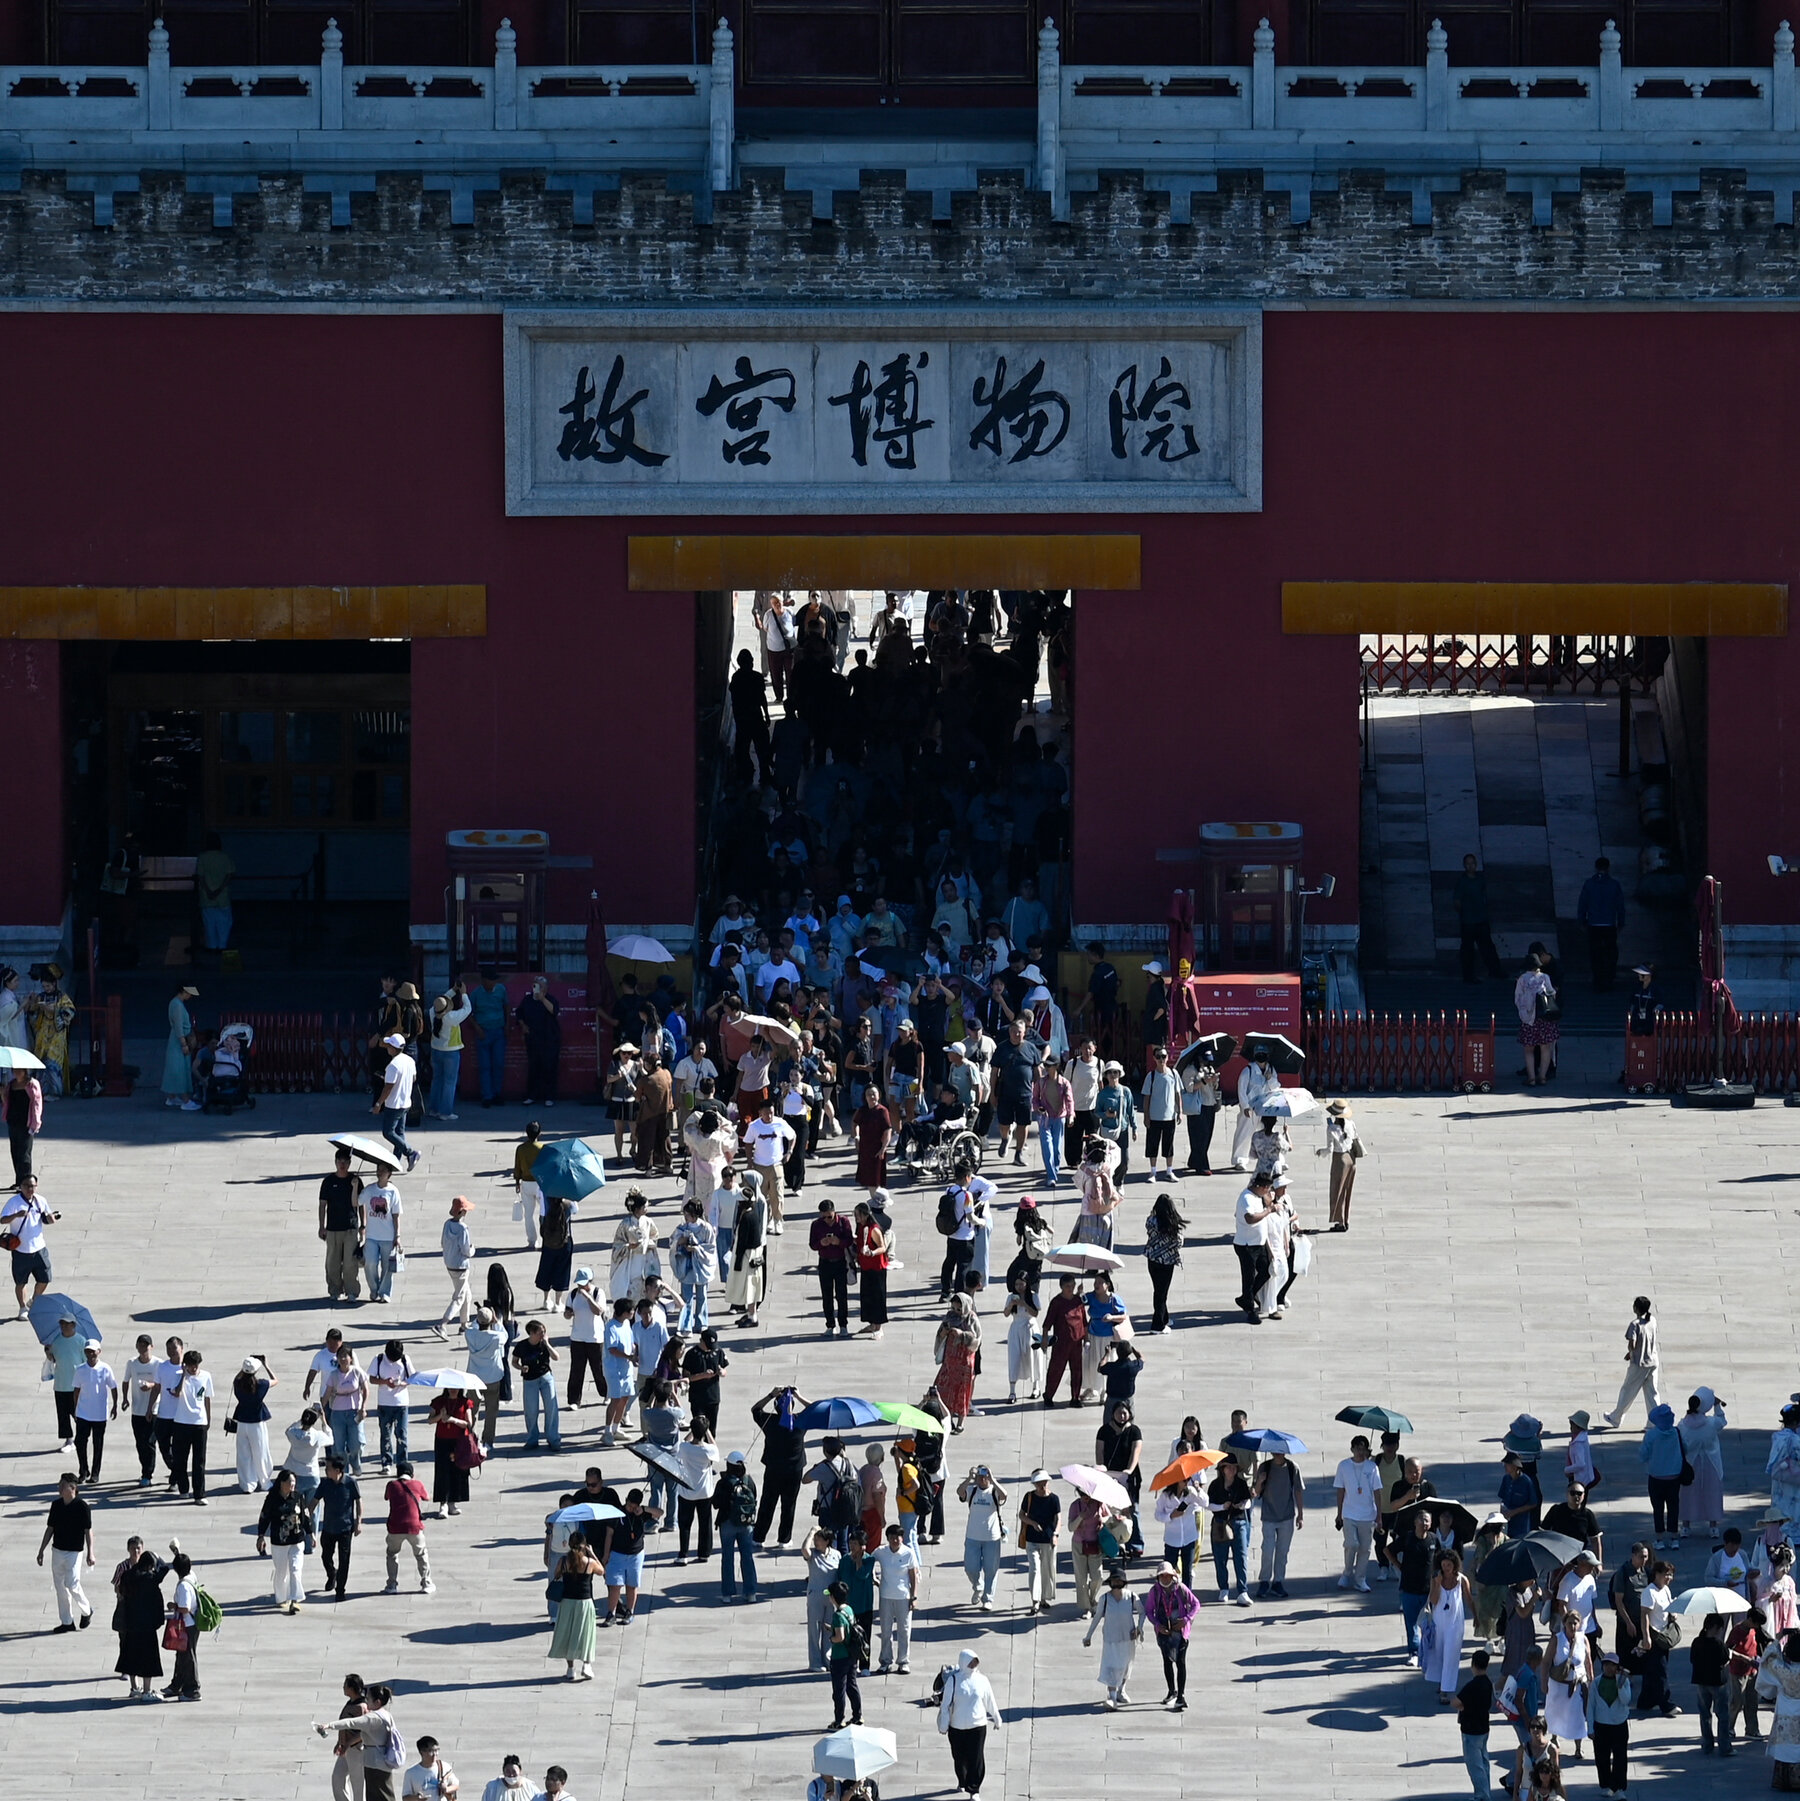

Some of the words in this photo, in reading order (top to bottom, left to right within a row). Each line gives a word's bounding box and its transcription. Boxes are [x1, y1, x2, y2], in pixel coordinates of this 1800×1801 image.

[556, 351, 1200, 469] 故宫博物院
